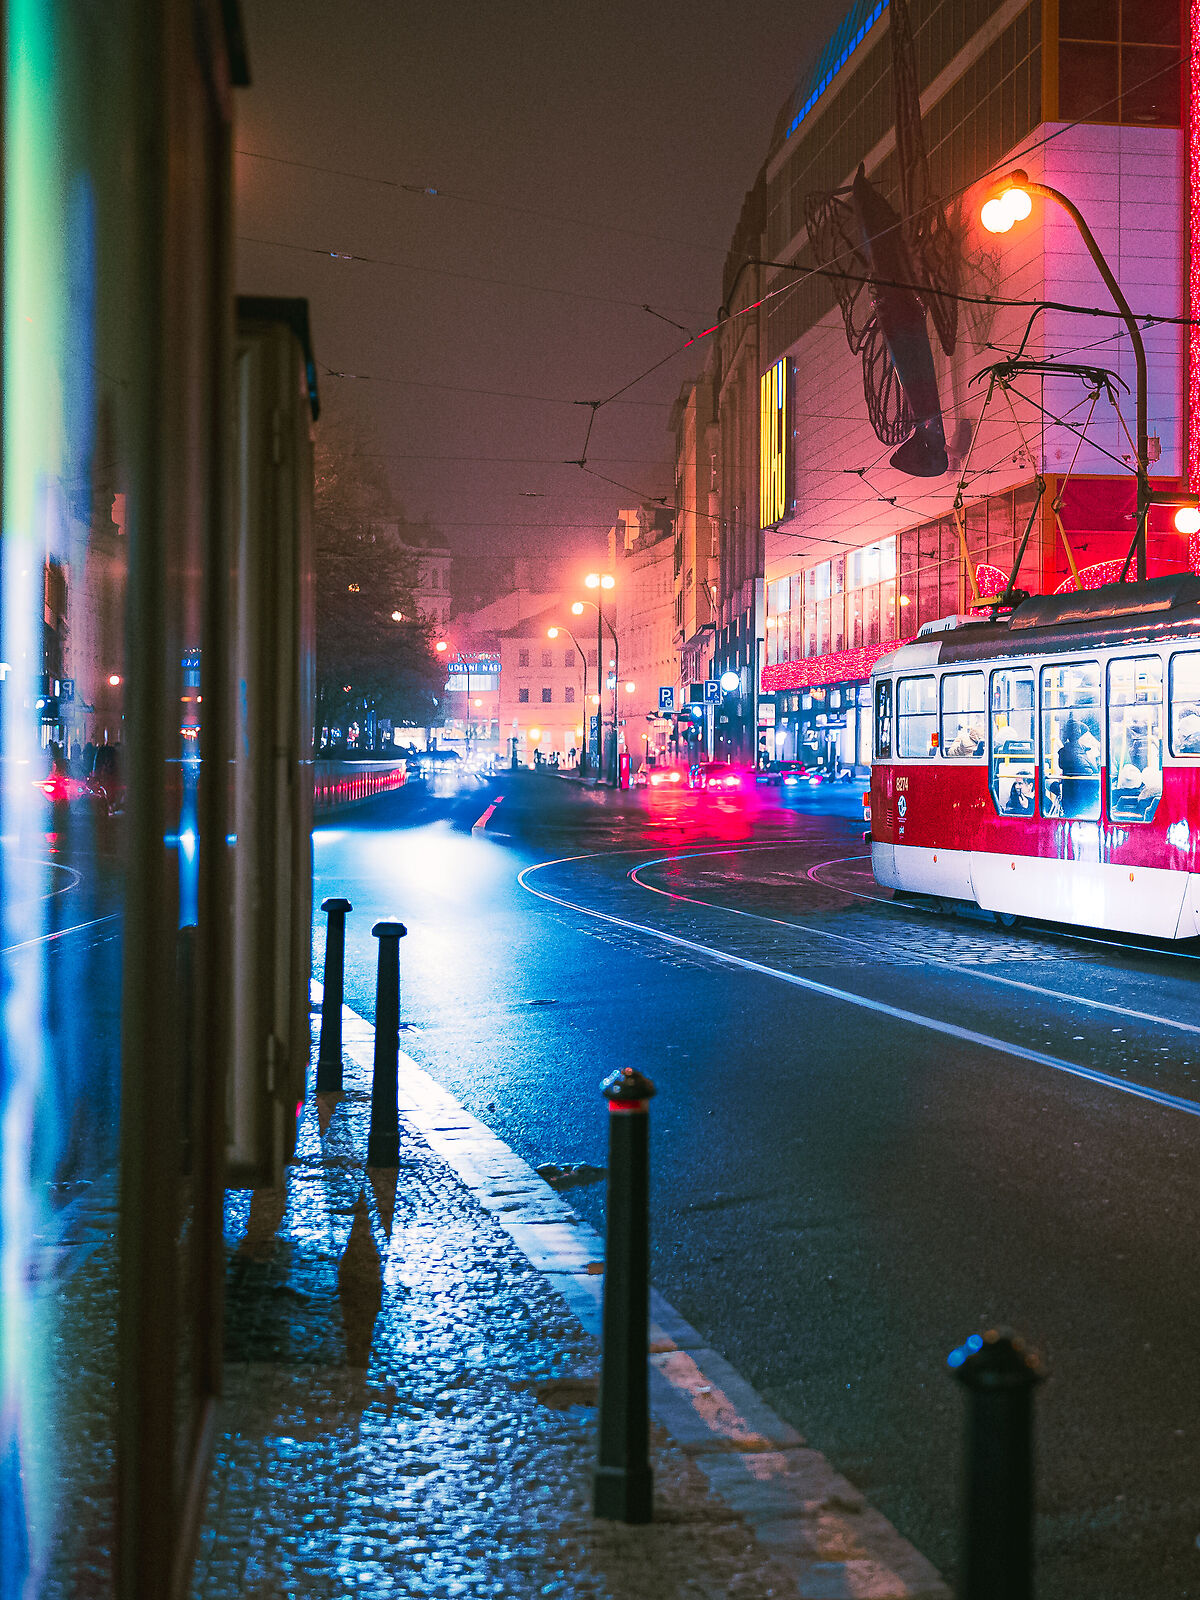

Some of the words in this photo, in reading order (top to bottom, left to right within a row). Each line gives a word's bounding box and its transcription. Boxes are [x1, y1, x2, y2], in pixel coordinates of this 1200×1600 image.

[661, 688, 671, 702] P
[707, 682, 718, 698] P
[895, 776, 909, 791] 8274
